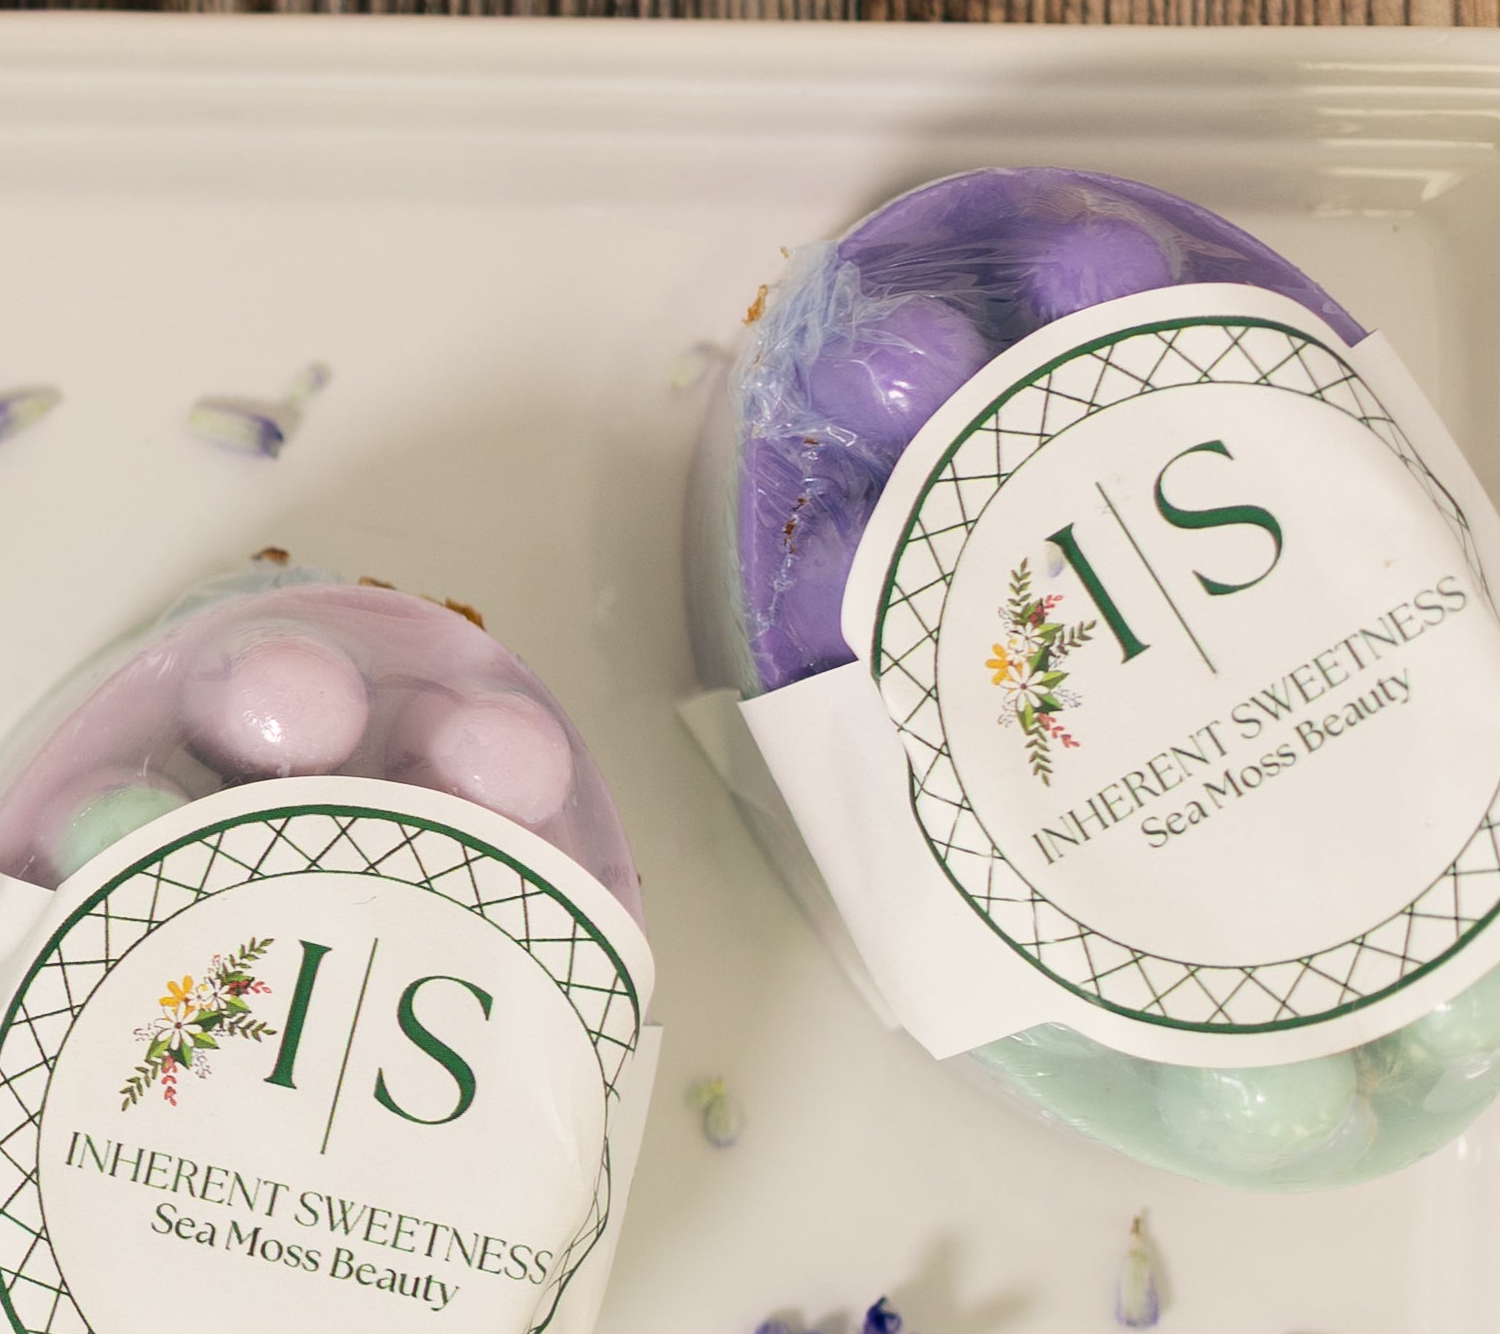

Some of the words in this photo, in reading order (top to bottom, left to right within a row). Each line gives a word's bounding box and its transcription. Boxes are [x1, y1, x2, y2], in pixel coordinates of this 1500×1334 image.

[1031, 721, 1227, 865] INHERENT
[1231, 575, 1467, 739] SWEETNESS
[1141, 800, 1208, 848] Sea
[1202, 743, 1296, 809] Moss
[1294, 667, 1411, 752] Beauty
[65, 1131, 289, 1217] INHERENT
[294, 1191, 553, 1285] SWEETNESS
[150, 1202, 216, 1247] Sea
[225, 1221, 322, 1273] Moss
[329, 1247, 460, 1312] Beauty
